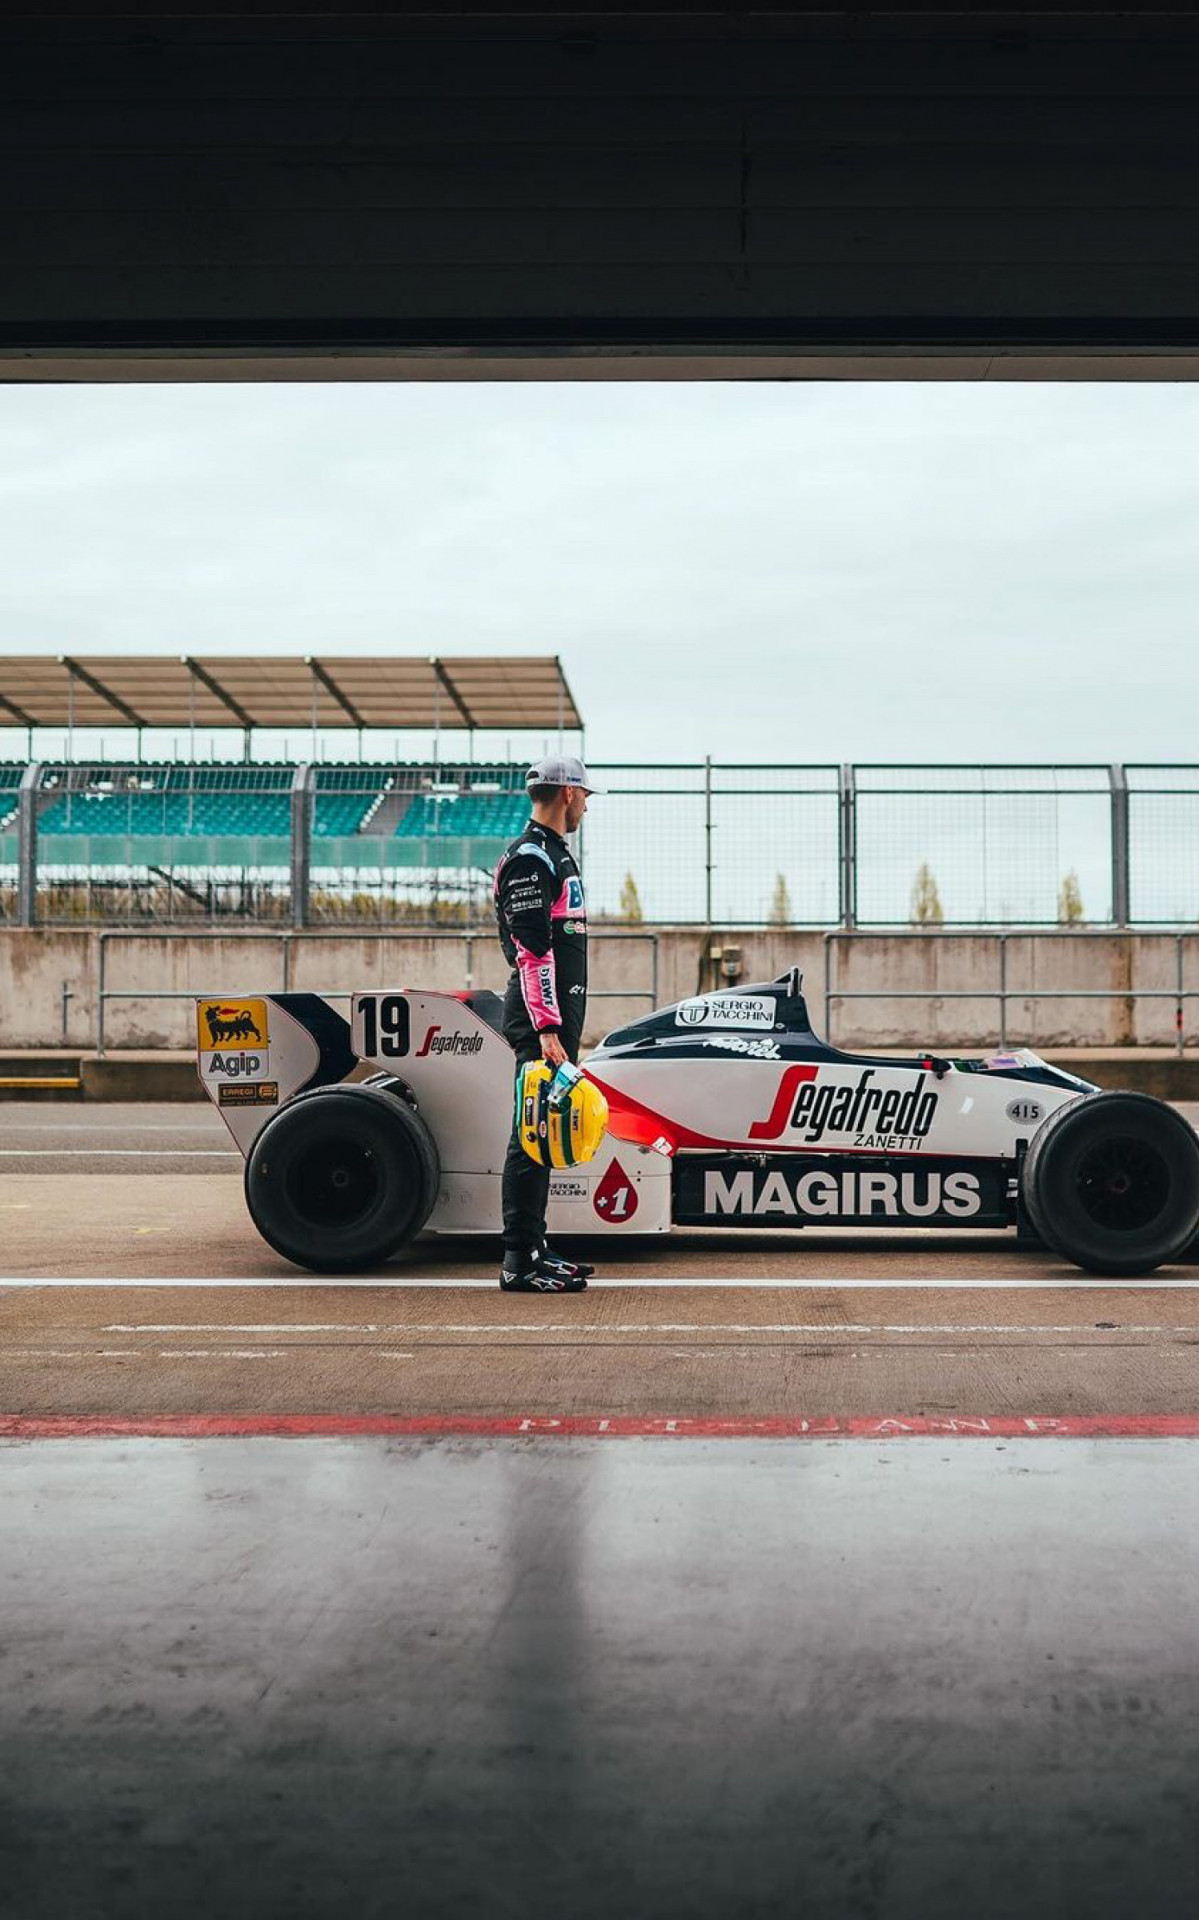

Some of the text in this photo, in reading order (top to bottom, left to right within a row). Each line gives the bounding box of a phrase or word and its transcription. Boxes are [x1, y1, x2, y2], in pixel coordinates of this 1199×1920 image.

[712, 1000, 764, 1011] SERGIO
[712, 1010, 773, 1022] TACCHINI
[358, 996, 410, 1058] 19
[415, 1025, 484, 1056] Segafredo
[209, 1052, 260, 1076] Agip
[747, 1064, 939, 1142] Segafredo
[1012, 1104, 1039, 1118] 415
[854, 1134, 923, 1150] ZANETTI
[704, 1170, 982, 1217] MAGIRUS
